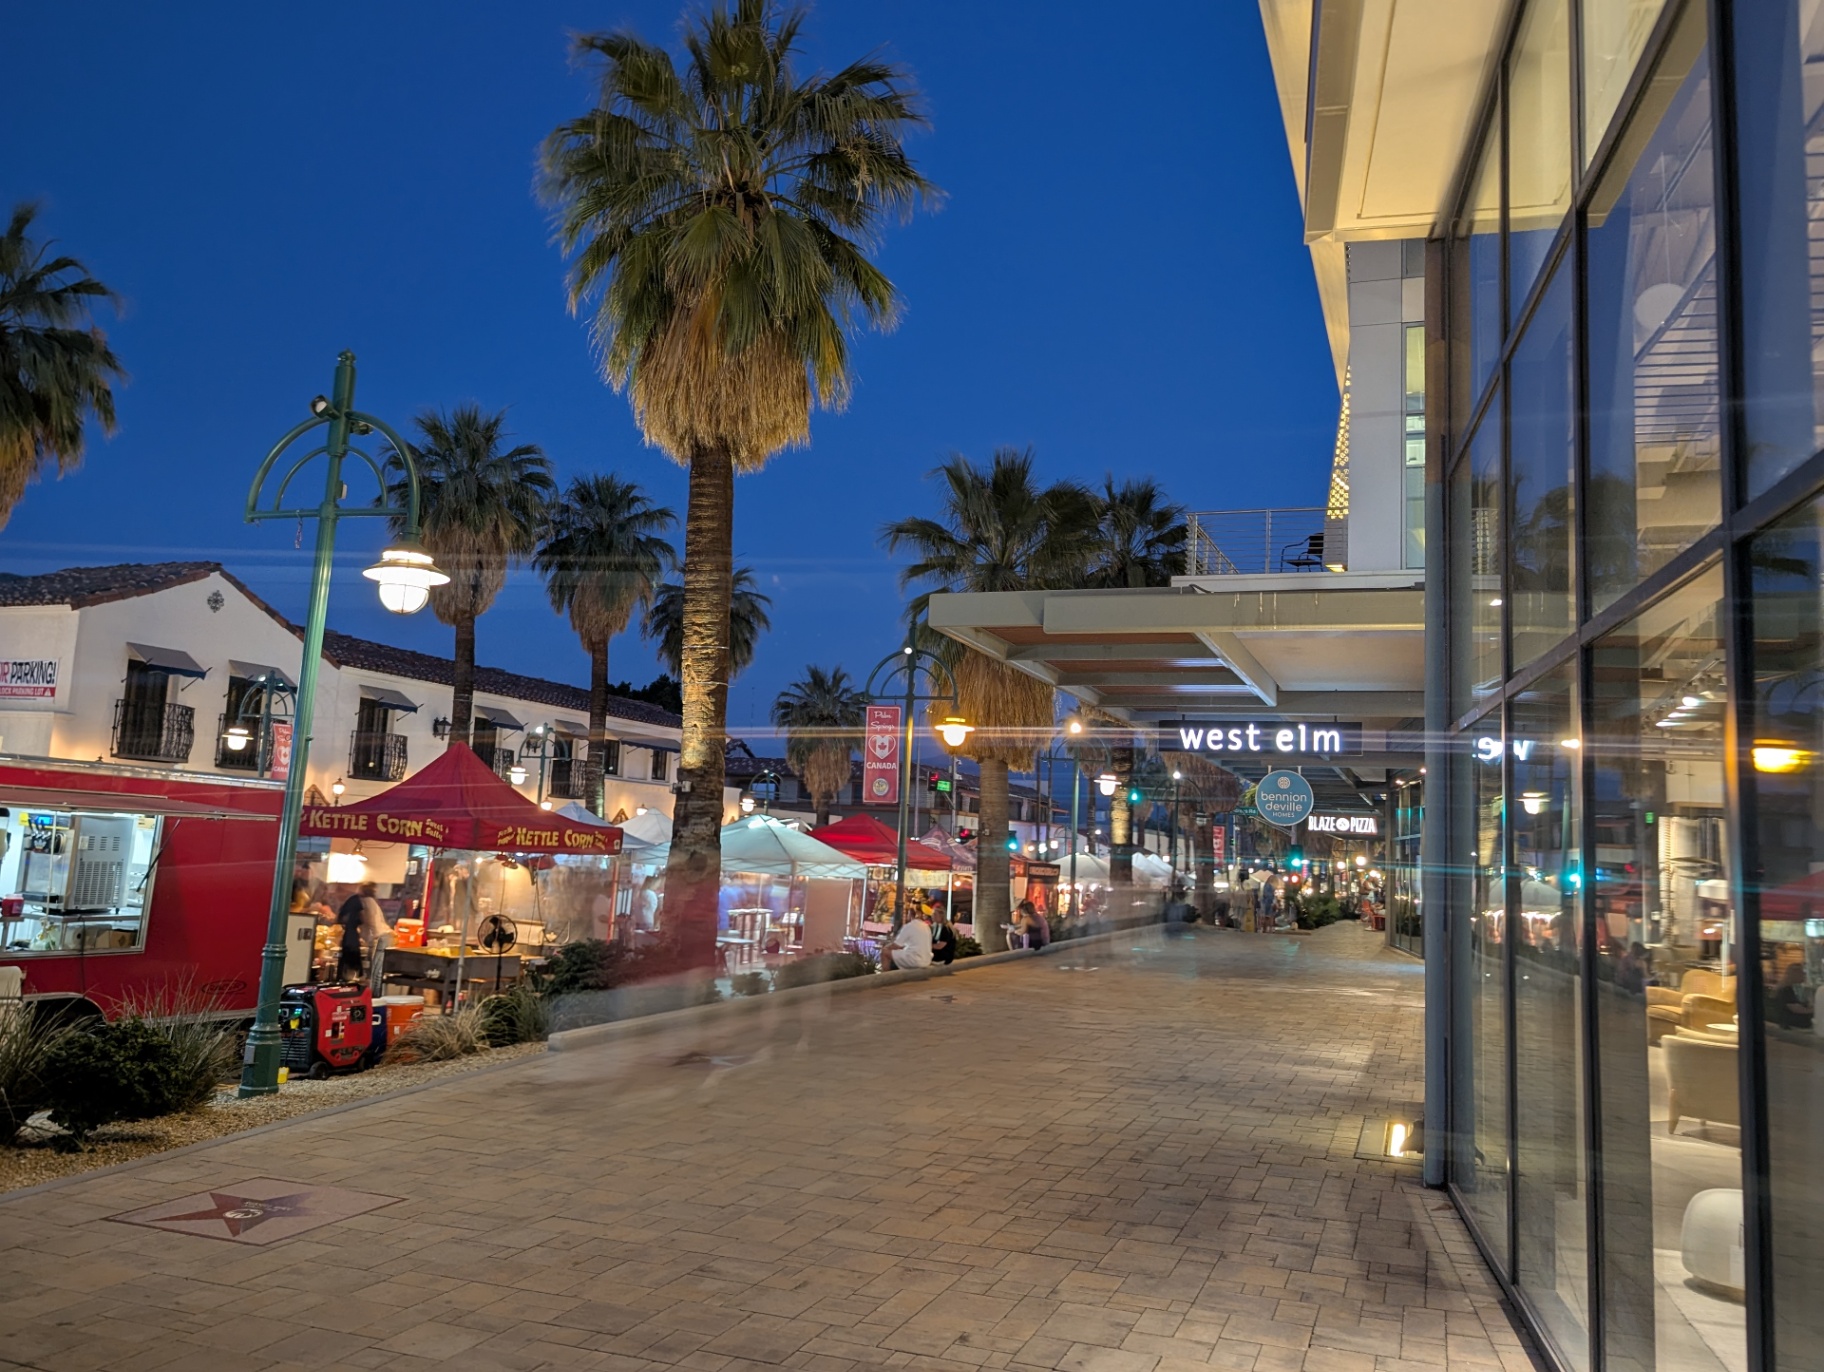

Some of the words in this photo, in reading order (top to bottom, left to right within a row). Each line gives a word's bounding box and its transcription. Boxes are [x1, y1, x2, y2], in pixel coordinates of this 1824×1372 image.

[10, 661, 56, 684] PARKING!
[870, 721, 895, 731] Springs
[1179, 723, 1260, 751] west
[1275, 723, 1341, 753] elm
[866, 761, 897, 770] CANADA
[1261, 791, 1307, 802] bennion
[1265, 801, 1303, 812] deville
[309, 809, 368, 831] KETTLE
[376, 813, 423, 837] CORN
[1308, 815, 1336, 832] BLAZE
[1350, 816, 1377, 833] PIZZA
[516, 827, 559, 847] KETTLE
